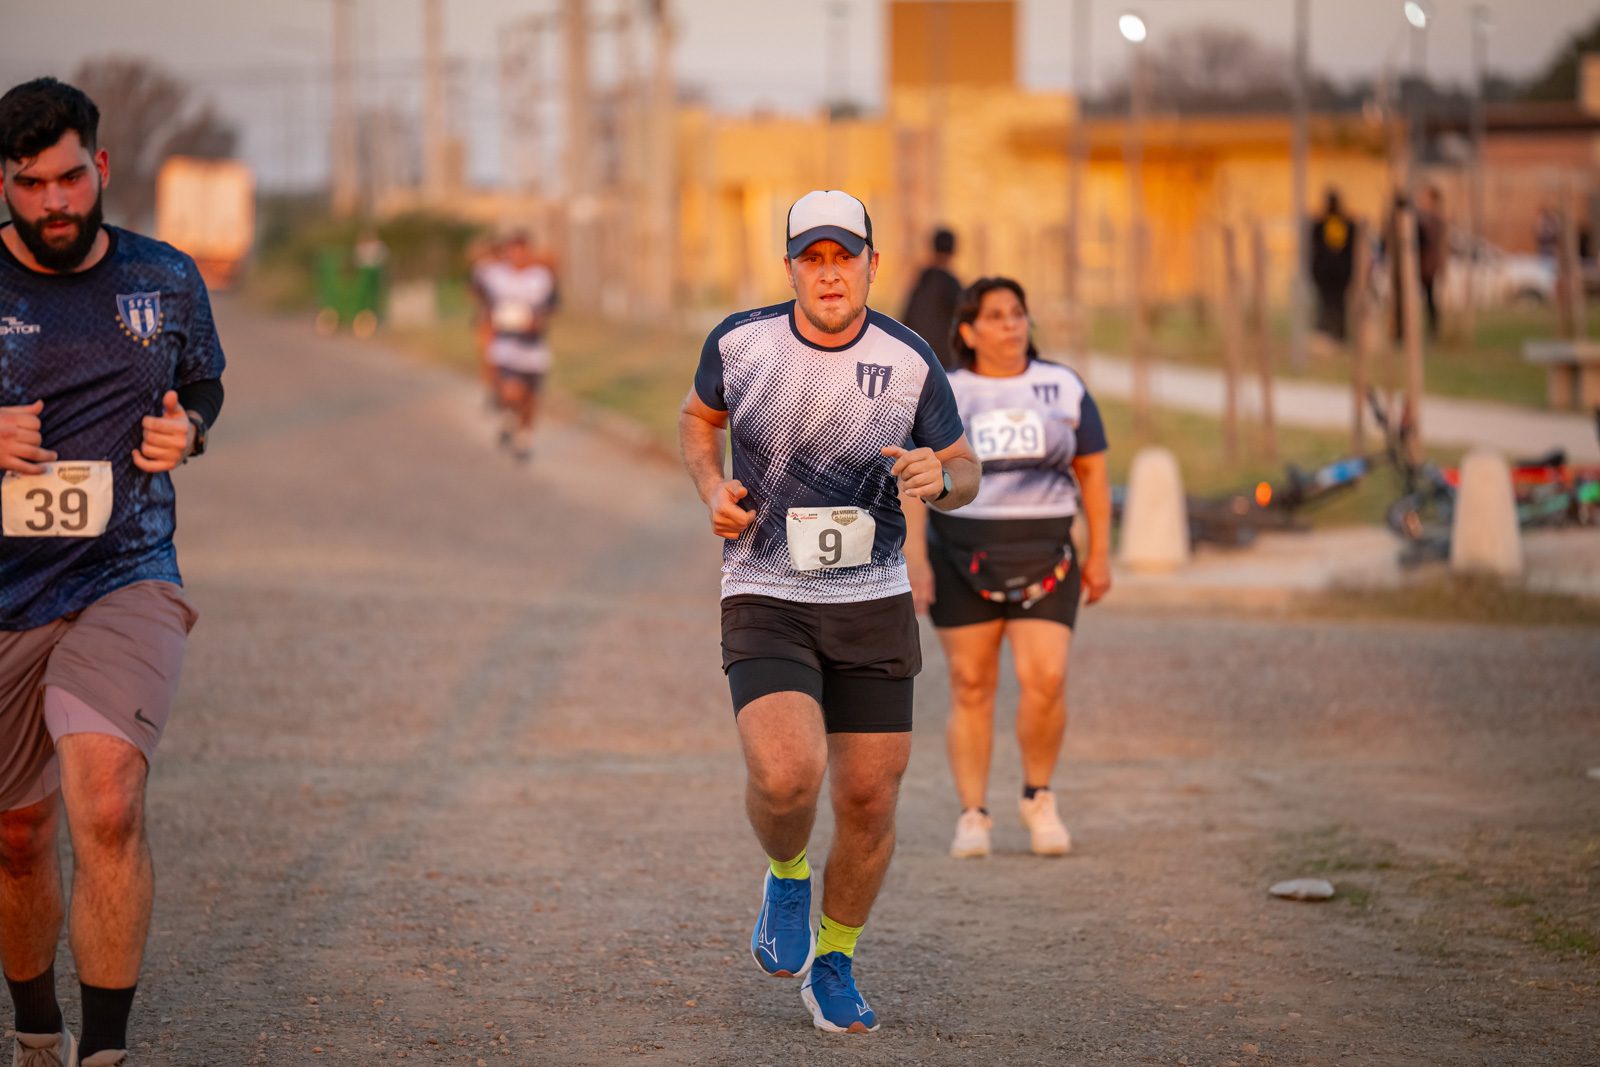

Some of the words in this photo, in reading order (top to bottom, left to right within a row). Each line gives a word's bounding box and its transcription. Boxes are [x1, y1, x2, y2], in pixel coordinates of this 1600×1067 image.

[863, 365, 886, 376] SFC
[977, 424, 1039, 455] 529
[25, 487, 89, 532] 39
[818, 528, 843, 566] 9
